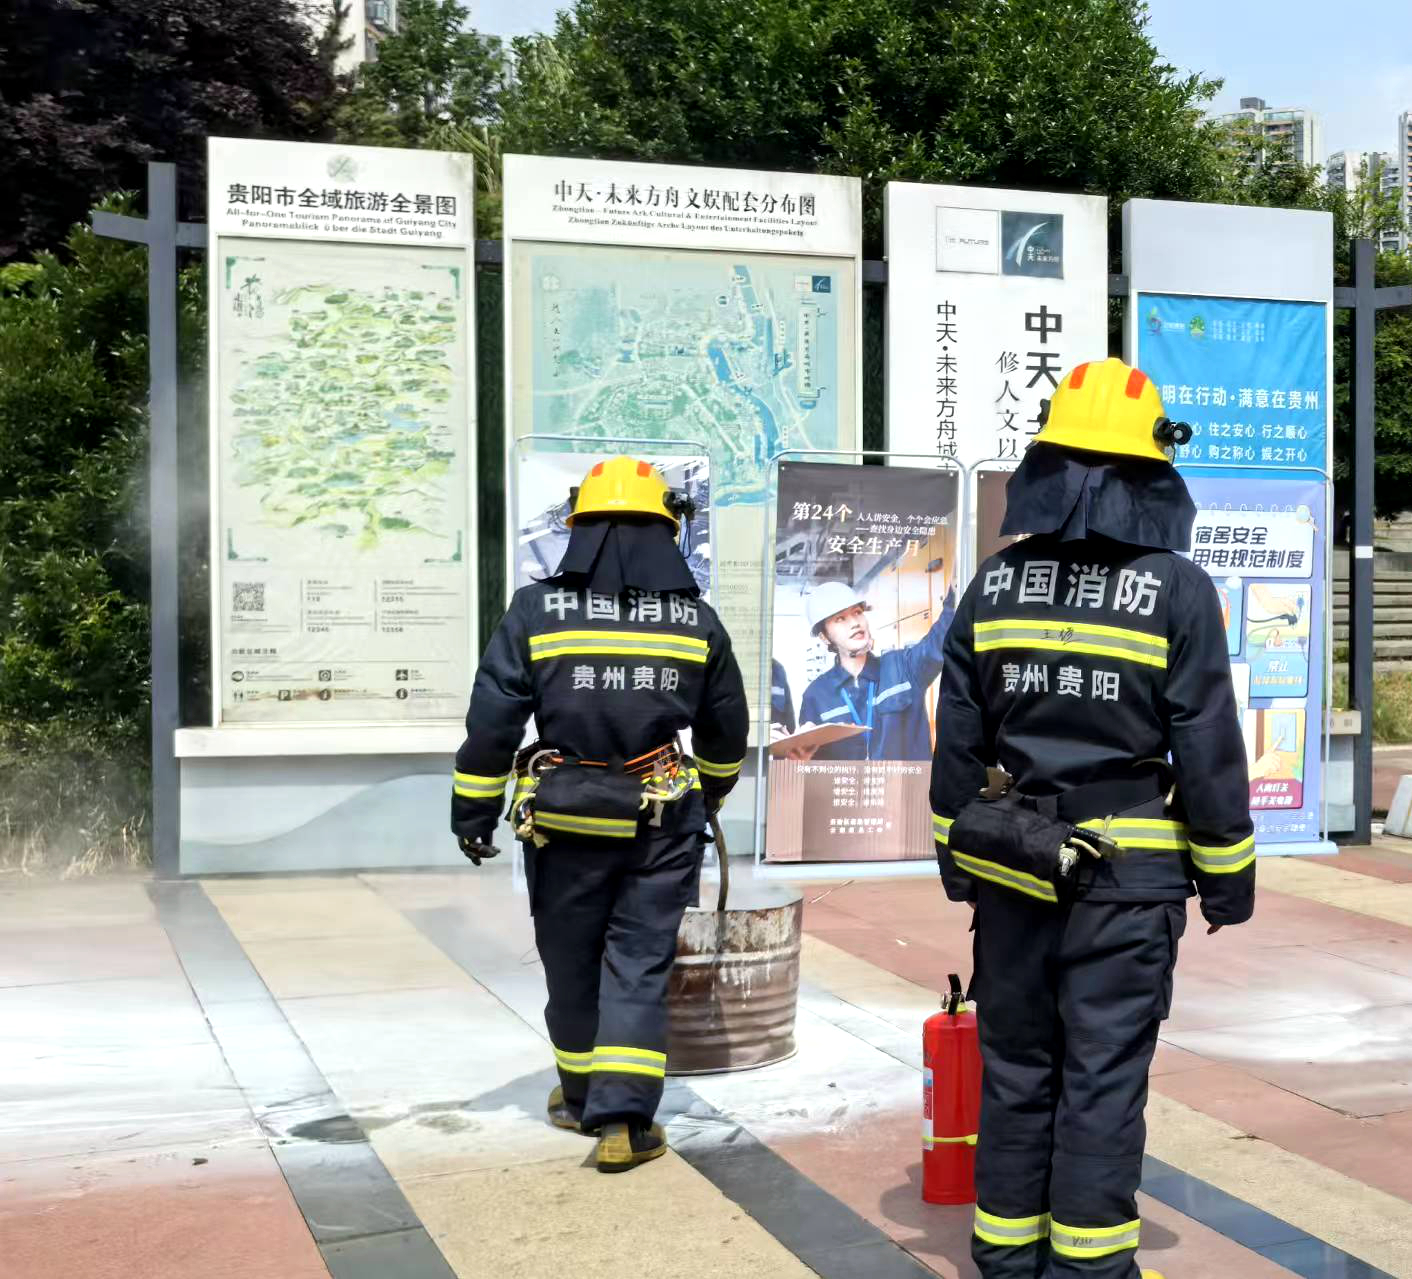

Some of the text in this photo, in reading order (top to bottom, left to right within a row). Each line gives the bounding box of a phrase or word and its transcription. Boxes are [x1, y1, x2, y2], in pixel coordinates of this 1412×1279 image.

[226, 183, 457, 216] 贵阳市全域旅游全景图
[554, 179, 816, 217] 中天·未来方舟文娱配套分布图
[289, 211, 329, 221] Tourism
[332, 214, 382, 224] Panorama
[395, 217, 436, 228] Guiyang
[438, 219, 456, 229] City
[351, 225, 367, 233] die
[370, 226, 397, 235] Stadt
[400, 227, 442, 239] Guiyang
[1025, 305, 1063, 436] 中天
[936, 300, 958, 470] 中天·未来方舟城
[1158, 384, 1320, 411] 明在行动·满意在贵州
[995, 351, 1020, 472] 修人文以
[1209, 421, 1256, 438] 住之安心
[1261, 424, 1309, 441] 行之顺心
[791, 501, 853, 522] 第24个
[827, 535, 921, 556] 安全生产月
[1195, 526, 1269, 545] 宿舍安全
[1192, 549, 1305, 569] 用电规范制度
[984, 560, 1162, 616] 中国消防
[543, 588, 699, 626] 中国消防
[572, 665, 679, 693] 贵州贵阳
[1002, 662, 1120, 701] 贵州贵阳
